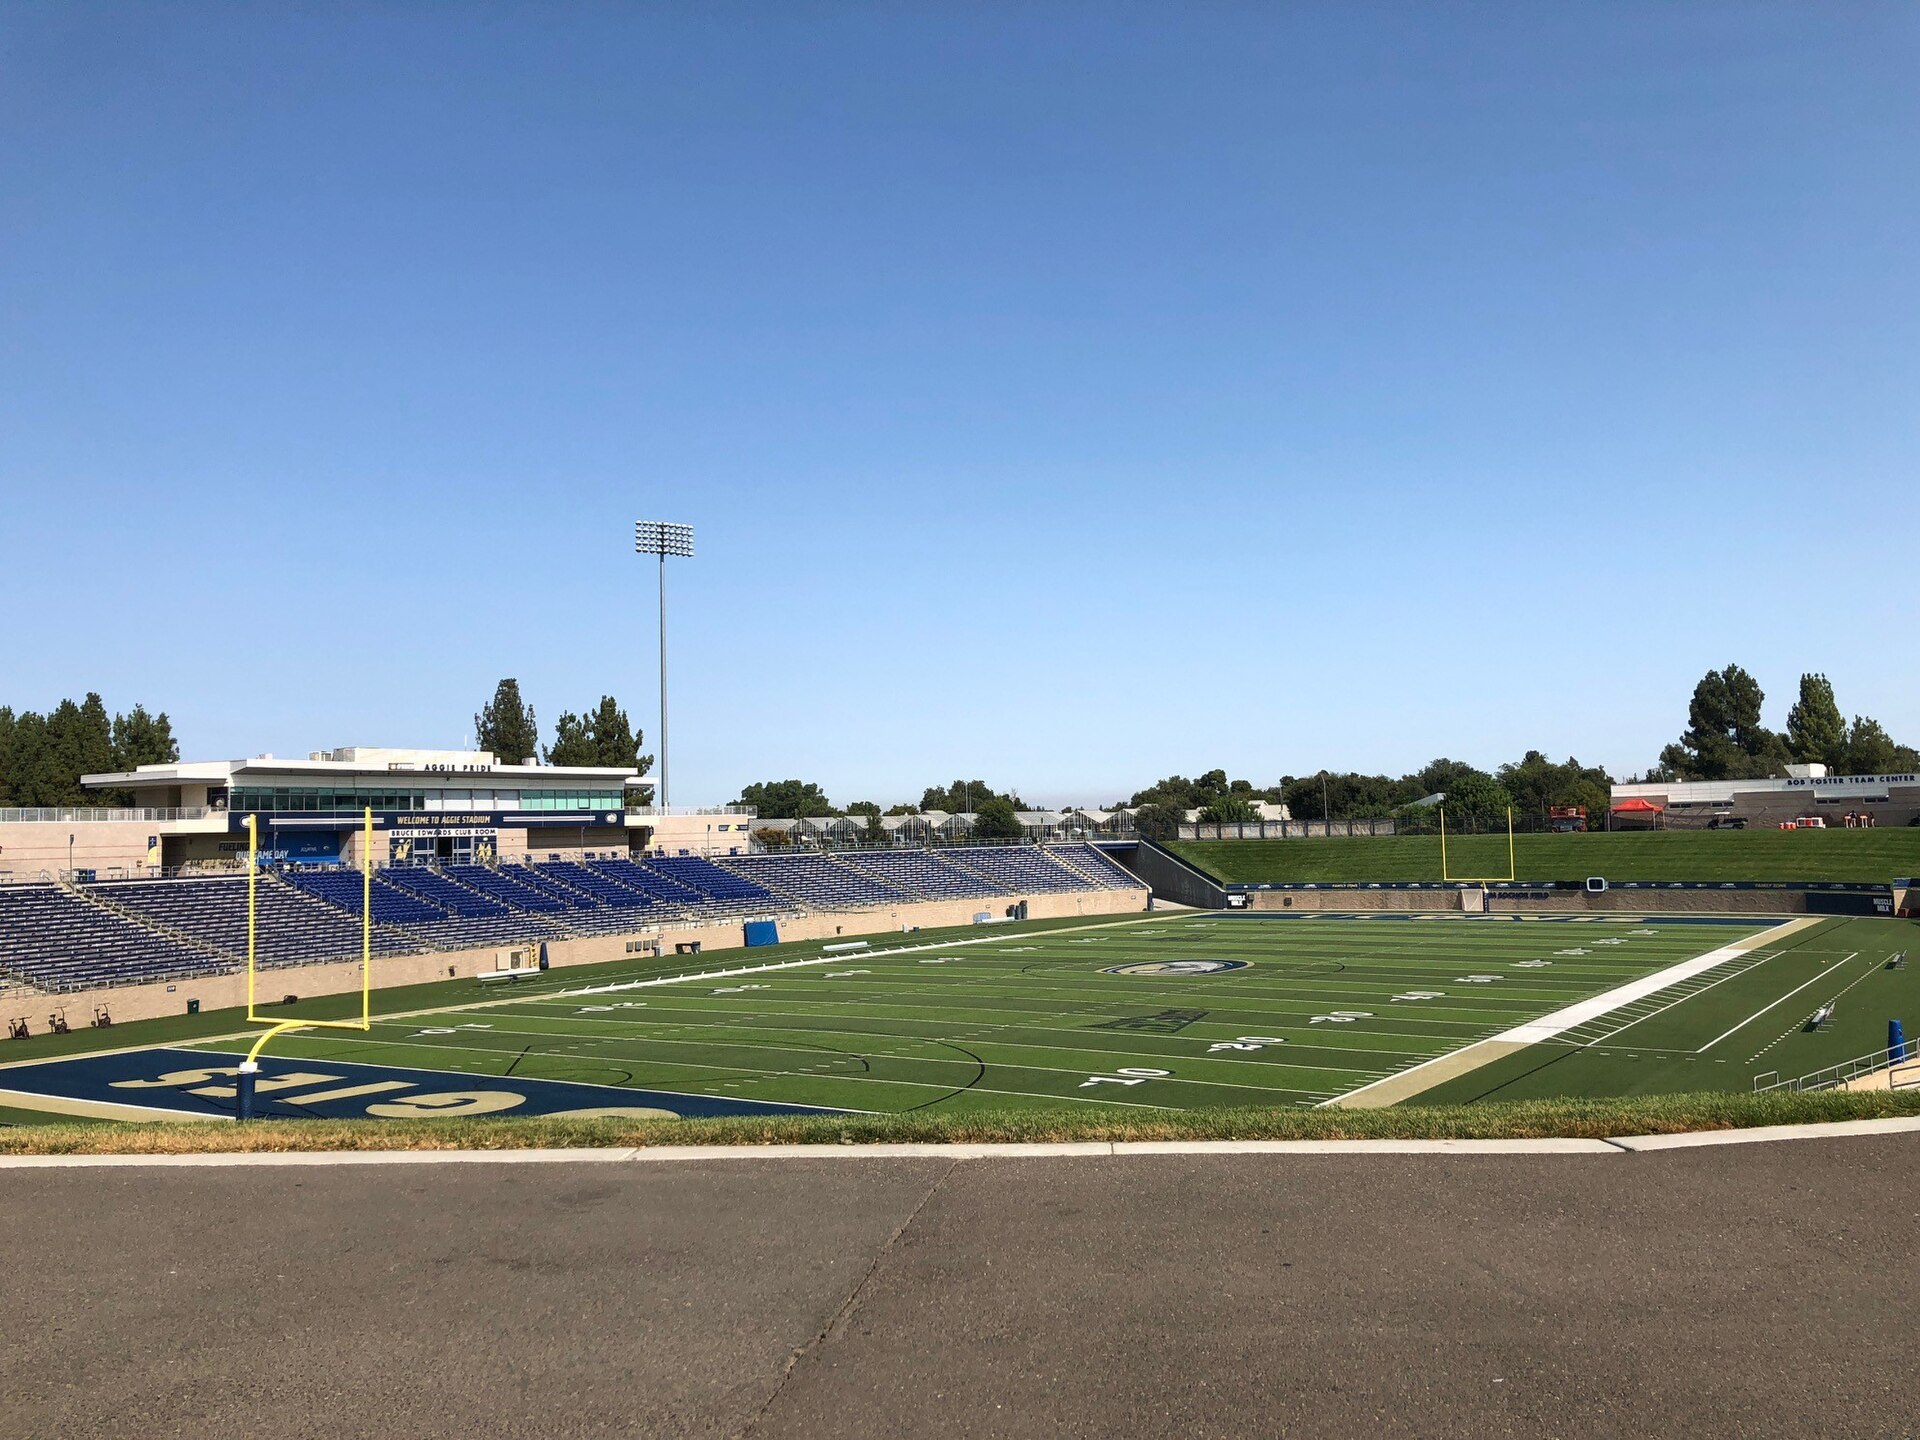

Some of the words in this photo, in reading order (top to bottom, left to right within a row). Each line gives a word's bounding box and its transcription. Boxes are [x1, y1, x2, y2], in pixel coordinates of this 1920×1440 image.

[397, 816, 430, 824] WELCOME
[431, 816, 439, 824] TO
[441, 816, 460, 824] AGGIE
[462, 815, 491, 824] STADIUM
[274, 850, 289, 859] DAY
[1210, 1036, 1285, 1051] 20
[1086, 1068, 1170, 1087] 10
